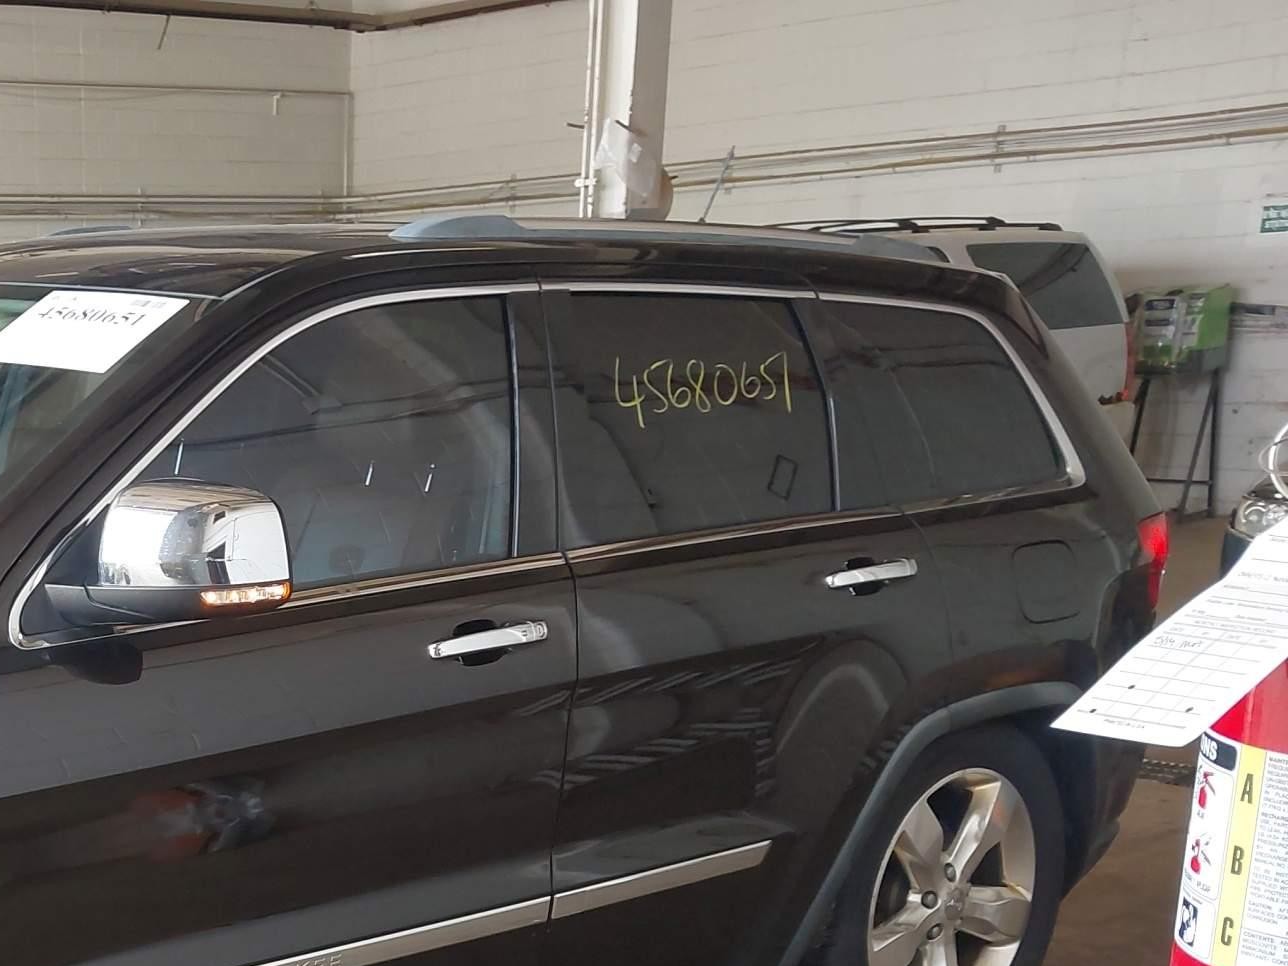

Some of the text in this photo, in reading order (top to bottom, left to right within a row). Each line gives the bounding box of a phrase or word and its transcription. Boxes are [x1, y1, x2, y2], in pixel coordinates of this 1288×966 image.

[614, 351, 792, 429] 45680651
[1240, 772, 1254, 805] A
[1231, 845, 1245, 876] B
[1220, 916, 1234, 946] C
